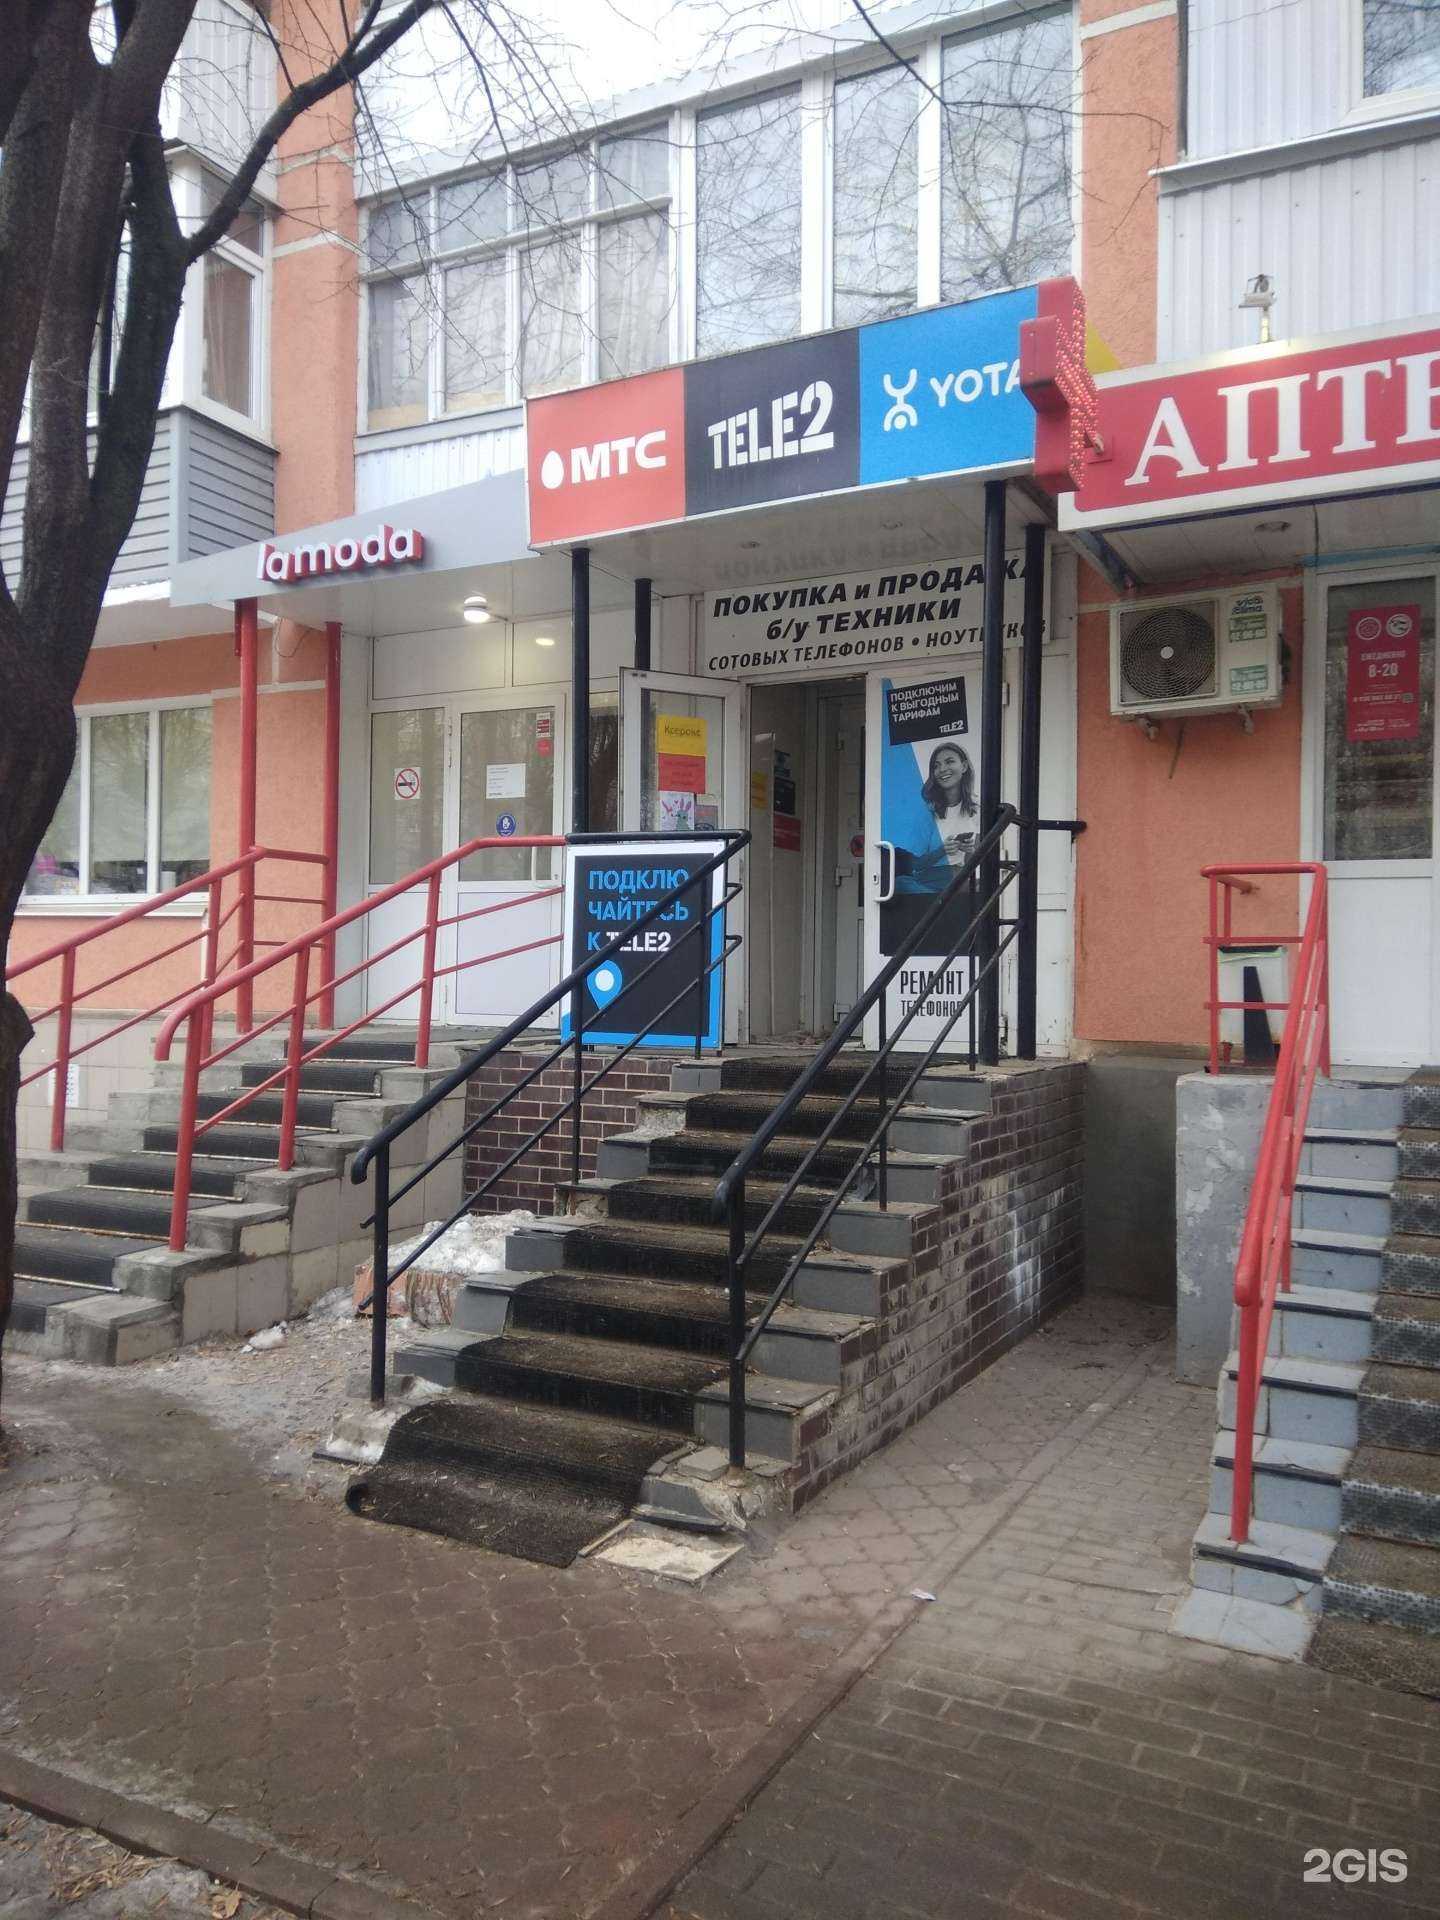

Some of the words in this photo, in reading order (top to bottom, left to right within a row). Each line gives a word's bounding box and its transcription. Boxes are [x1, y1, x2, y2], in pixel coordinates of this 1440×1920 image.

[707, 380, 834, 469] TELE2
[570, 429, 667, 484] МТС
[256, 524, 424, 582] lamoda
[713, 582, 847, 618] ПОКУПКА
[766, 617, 810, 643] б/у
[816, 598, 962, 634] ТЕХНИКИ
[708, 649, 790, 671] СОТОВЫХ
[794, 636, 905, 662] ТЕЛЕФОНОВ
[890, 682, 957, 703] ПОДКЛЮЧИМ
[891, 704, 898, 713] К
[900, 692, 959, 711] ВЫГОДНЫМ
[892, 707, 941, 722] ТАРИФАМ
[939, 720, 964, 733] TELE2
[588, 868, 690, 894] ПОДКЛЮ
[586, 931, 601, 952] К
[900, 970, 964, 995] РЕМОНТ
